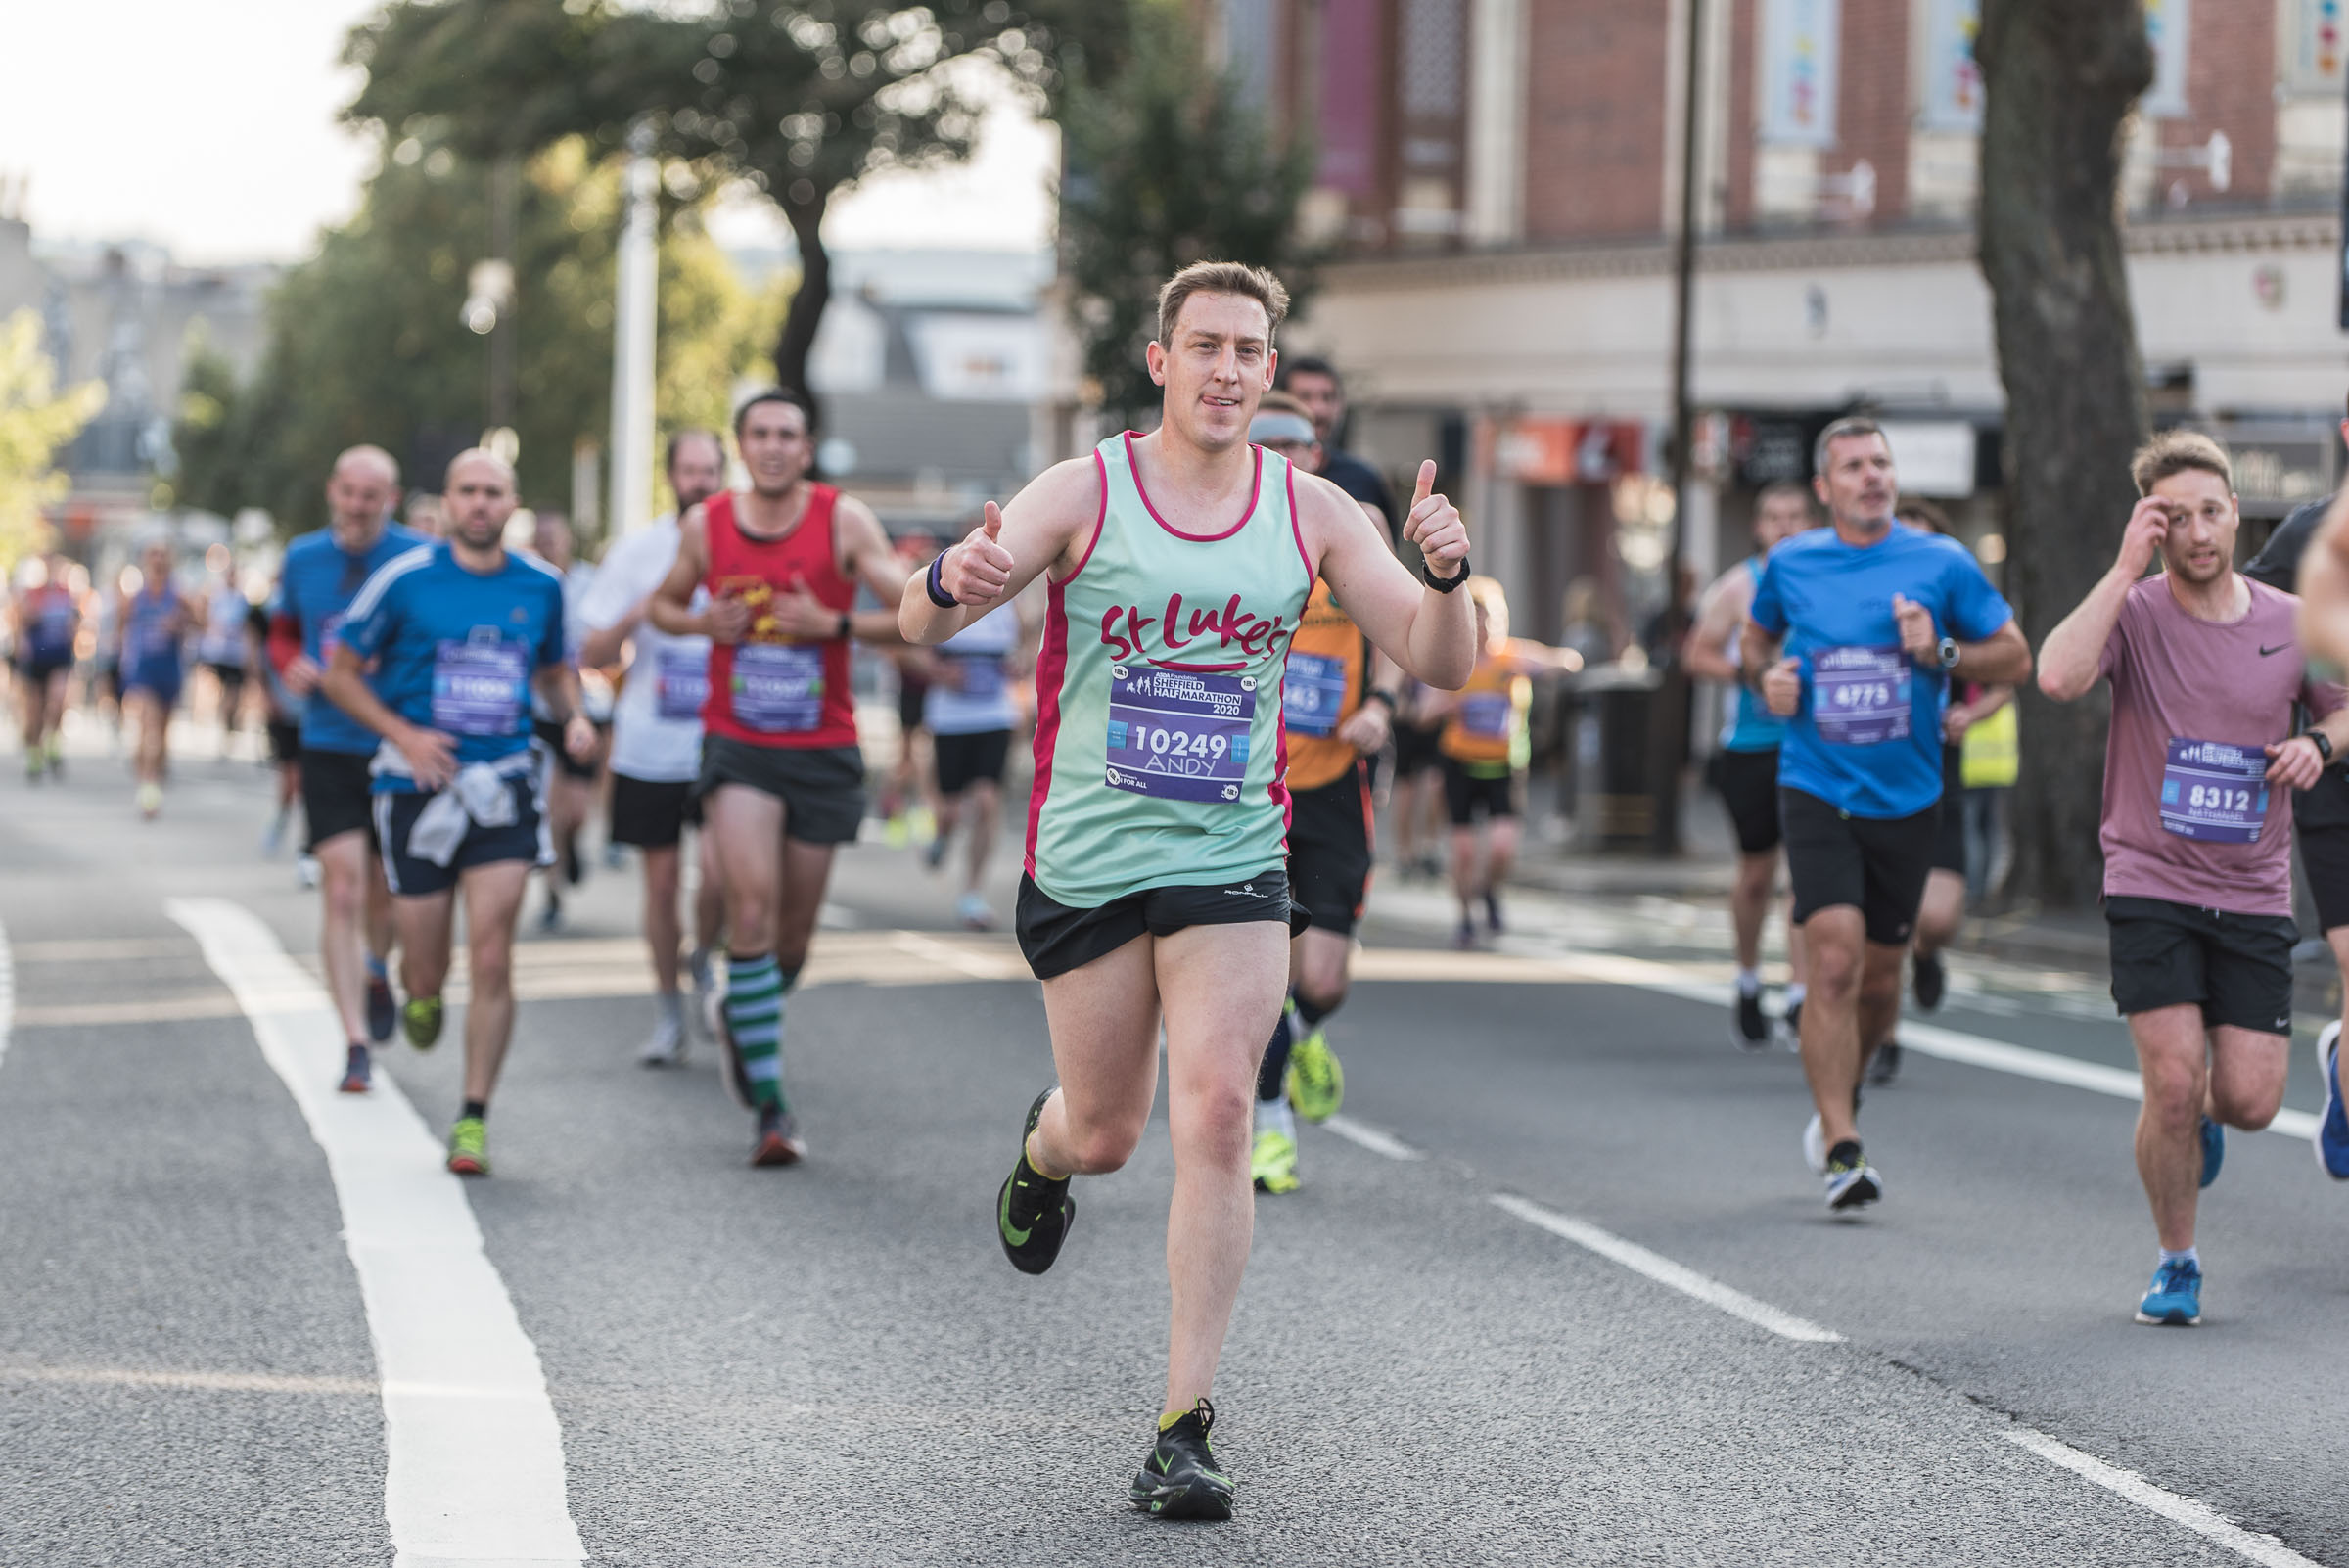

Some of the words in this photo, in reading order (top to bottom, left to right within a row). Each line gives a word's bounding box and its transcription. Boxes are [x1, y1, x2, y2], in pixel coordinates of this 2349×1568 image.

[1101, 605, 1157, 661] St
[1163, 593, 1288, 661] Luke's
[1155, 678, 1203, 691] SHEFFIELD
[1154, 688, 1180, 699] HALF
[1180, 691, 1241, 705] MARATHON
[1213, 704, 1240, 715] 2020
[1136, 725, 1227, 760] 10249
[1145, 755, 1216, 777] ANDY
[2189, 784, 2249, 812] 8312
